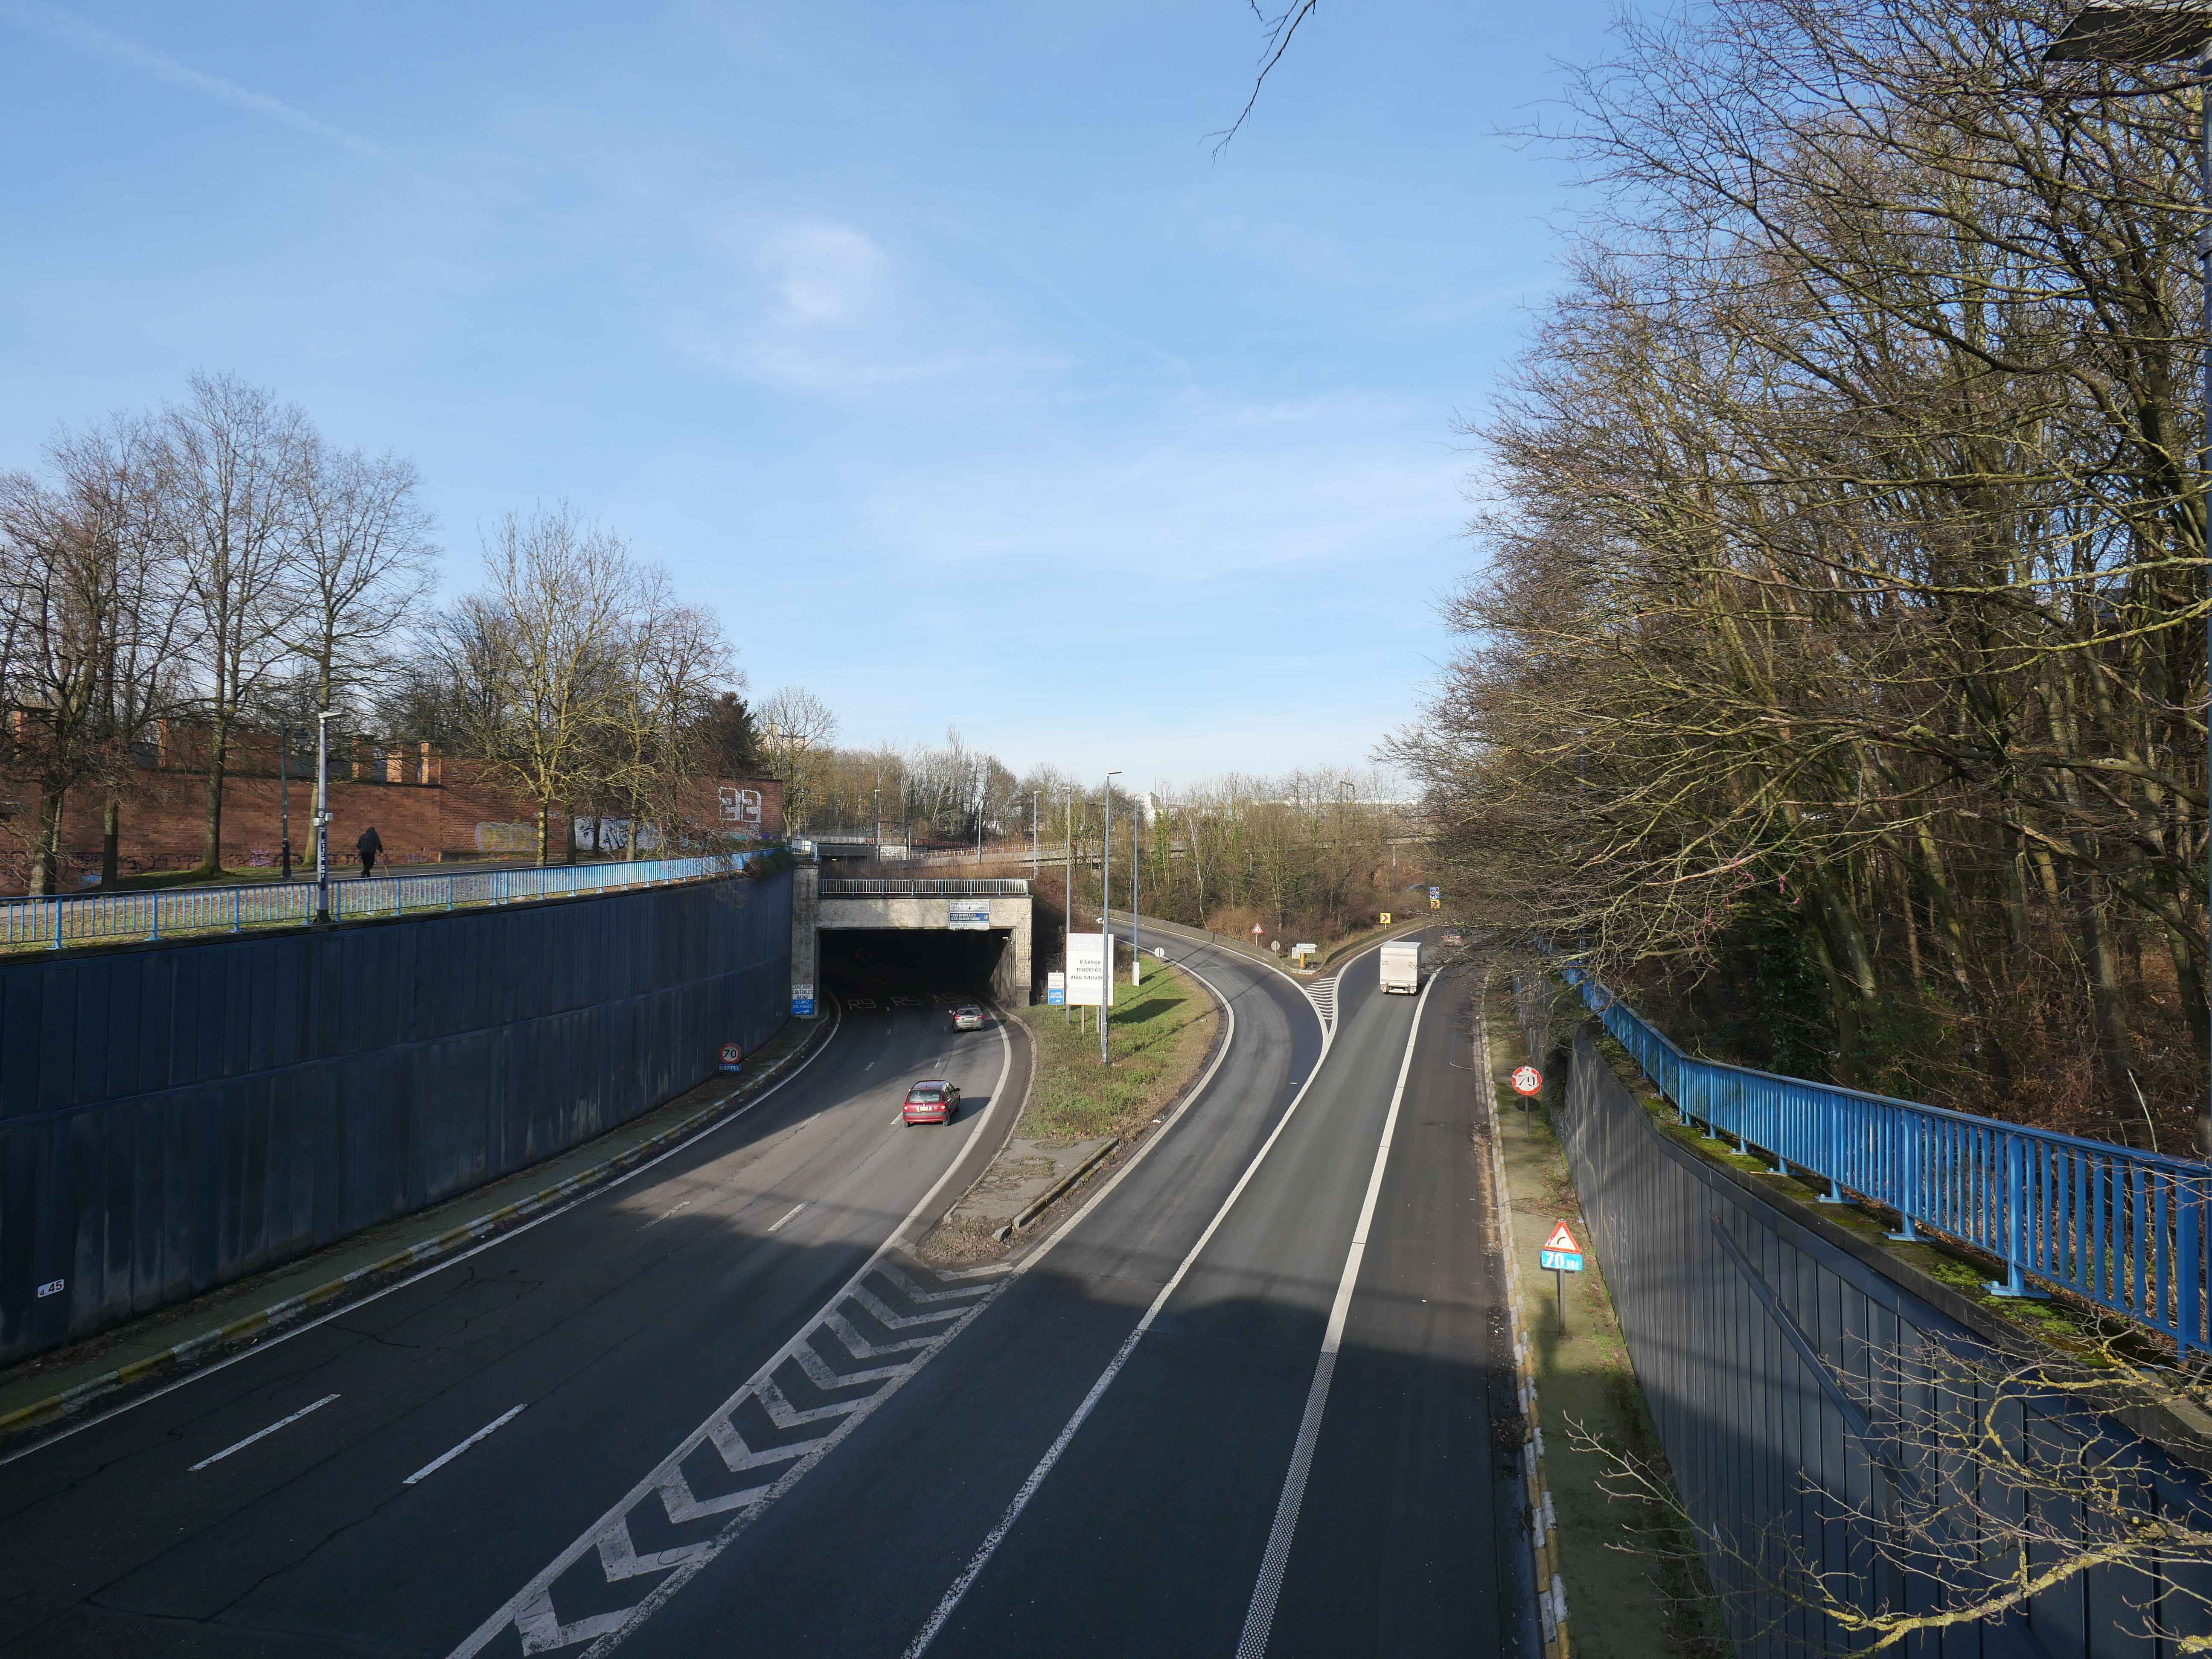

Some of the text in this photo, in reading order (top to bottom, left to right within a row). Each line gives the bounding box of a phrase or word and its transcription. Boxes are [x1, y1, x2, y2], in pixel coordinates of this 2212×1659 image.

[847, 998, 877, 1010] R9
[724, 1049, 736, 1058] 70
[1518, 1075, 1535, 1087] 70
[1545, 1252, 1580, 1270] 70 m
